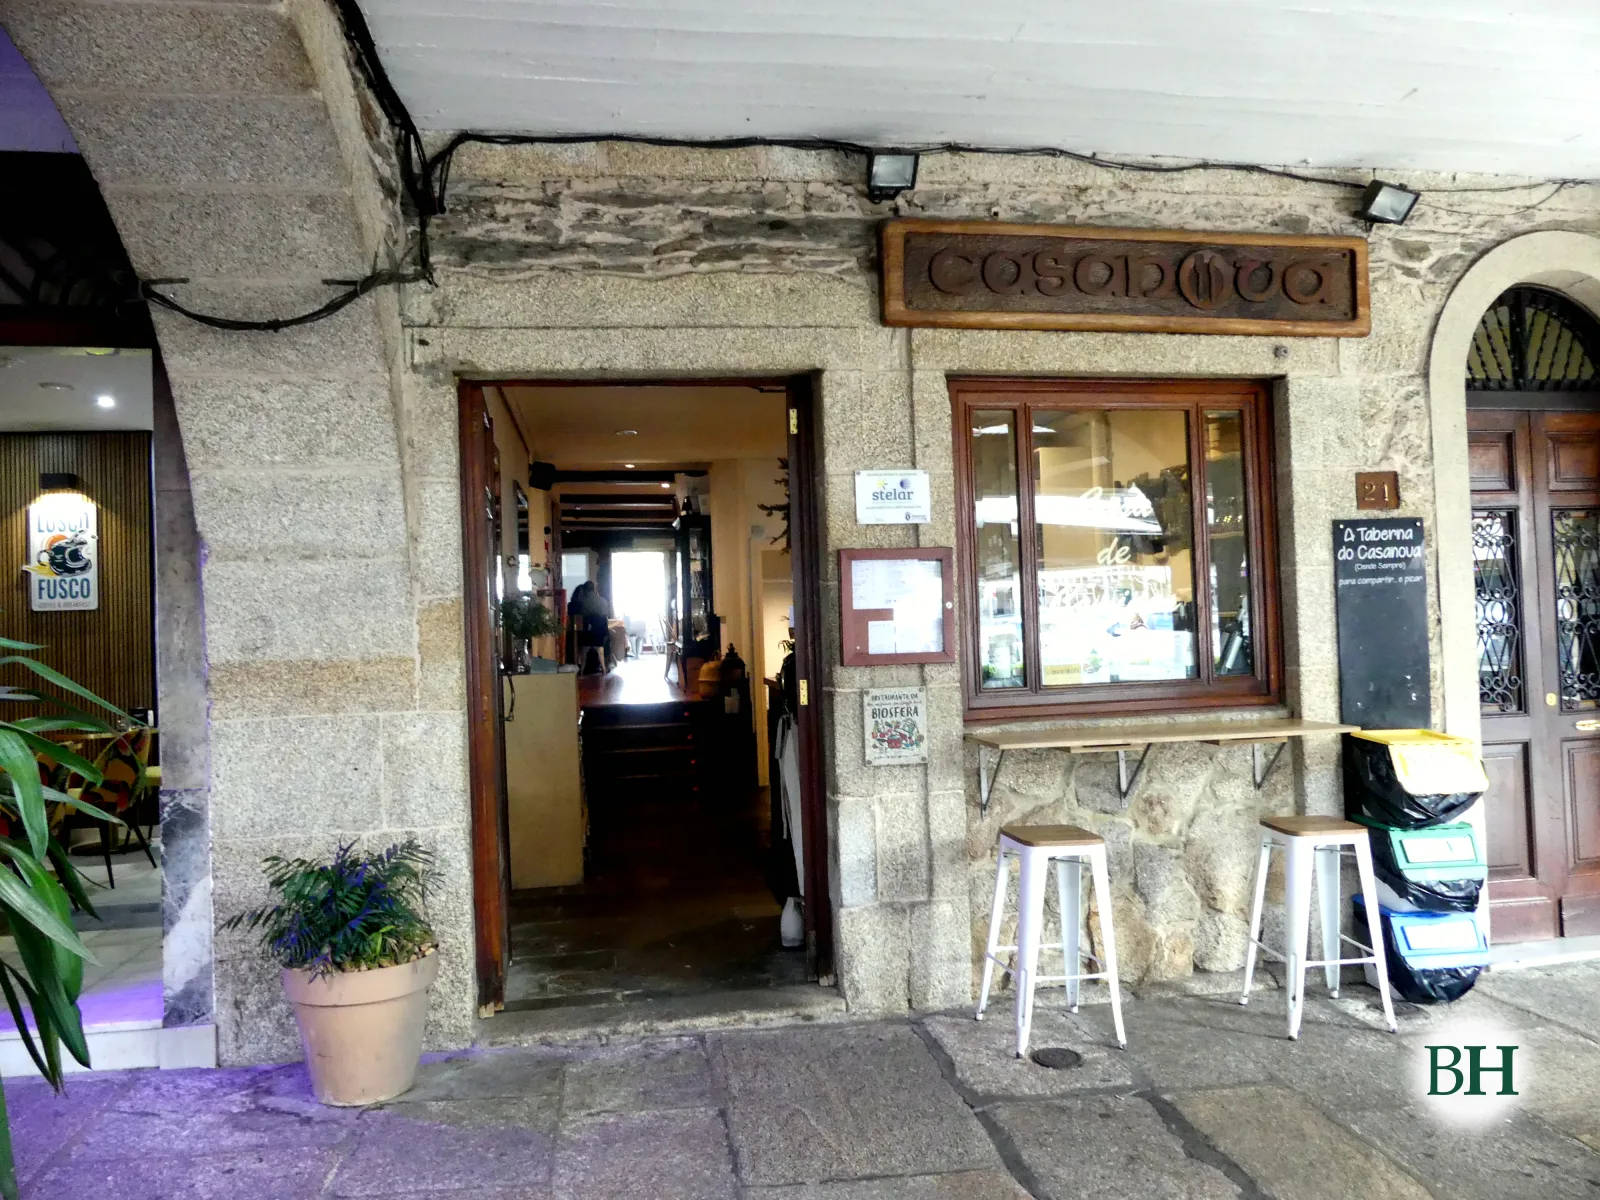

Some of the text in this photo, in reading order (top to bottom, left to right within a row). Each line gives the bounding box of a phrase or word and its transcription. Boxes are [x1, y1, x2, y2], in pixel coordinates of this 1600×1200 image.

[872, 488, 914, 501] stelar
[1363, 481, 1389, 502] 21
[1343, 526, 1414, 542] A Taberna
[1096, 537, 1132, 565] de
[1337, 545, 1354, 561] do
[38, 577, 91, 600] FUSCO
[872, 706, 919, 719] BIOSFERA
